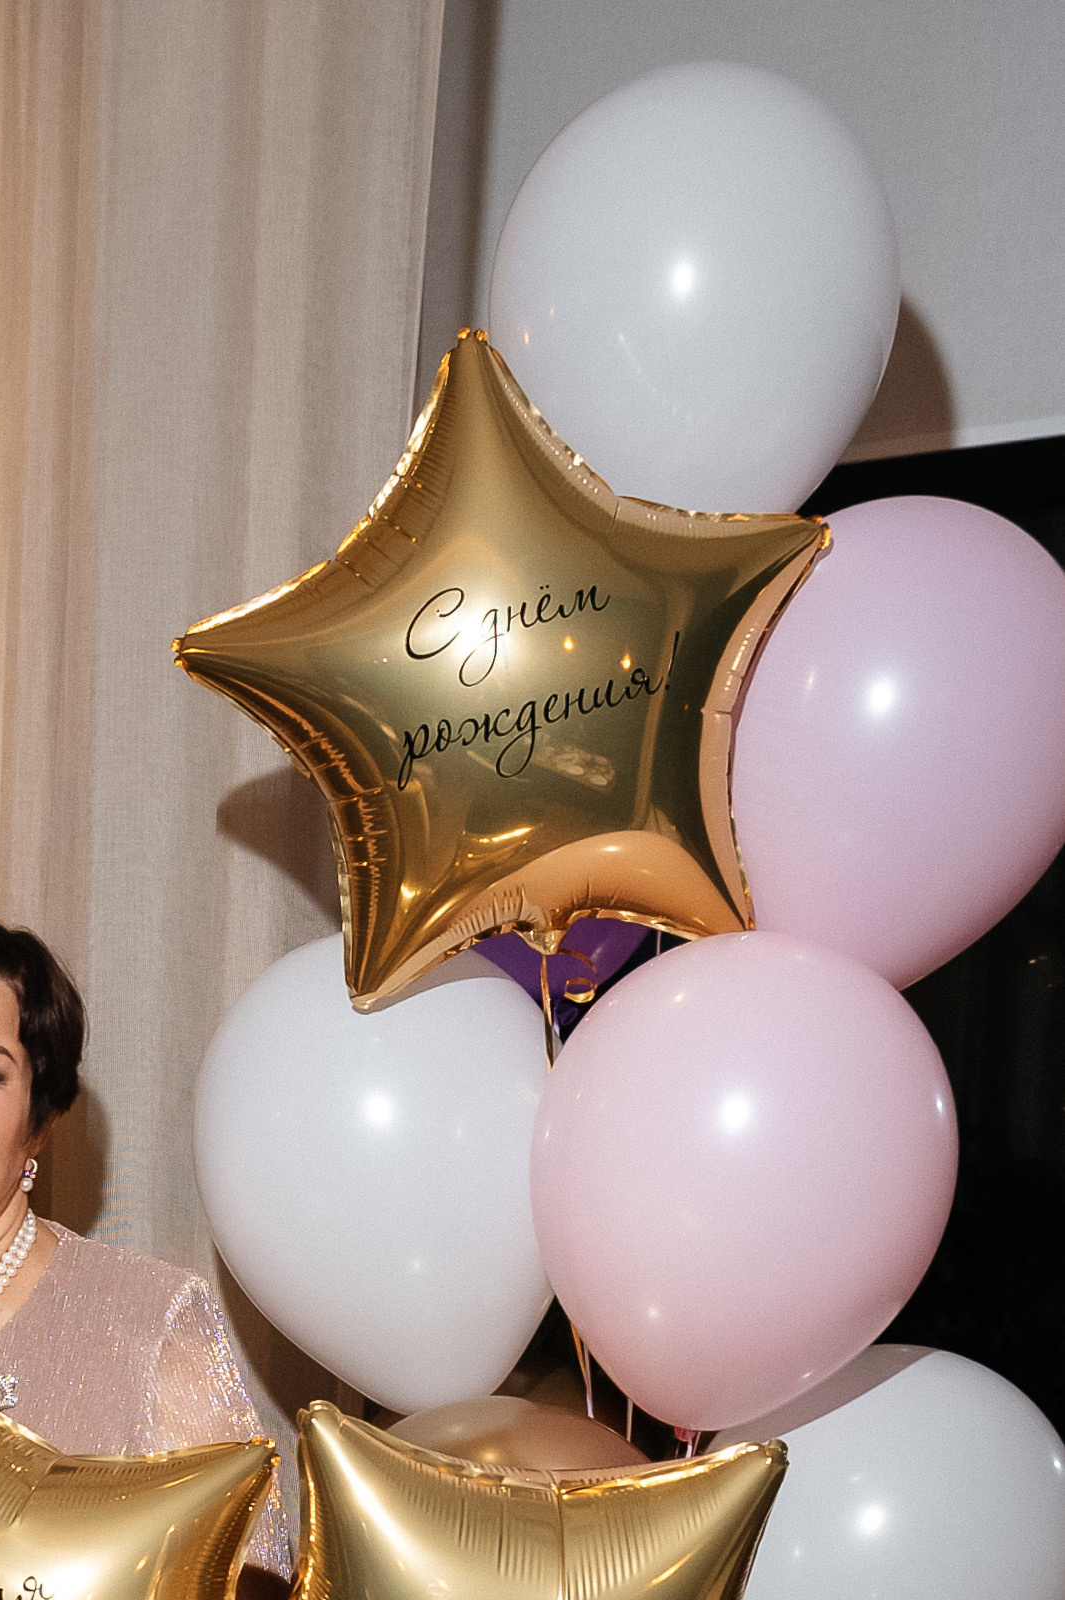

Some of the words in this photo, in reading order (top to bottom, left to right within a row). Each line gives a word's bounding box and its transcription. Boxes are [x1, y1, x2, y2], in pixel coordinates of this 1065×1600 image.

[404, 587, 465, 660] С
[458, 584, 611, 687] днём
[396, 630, 681, 792] рождения!
